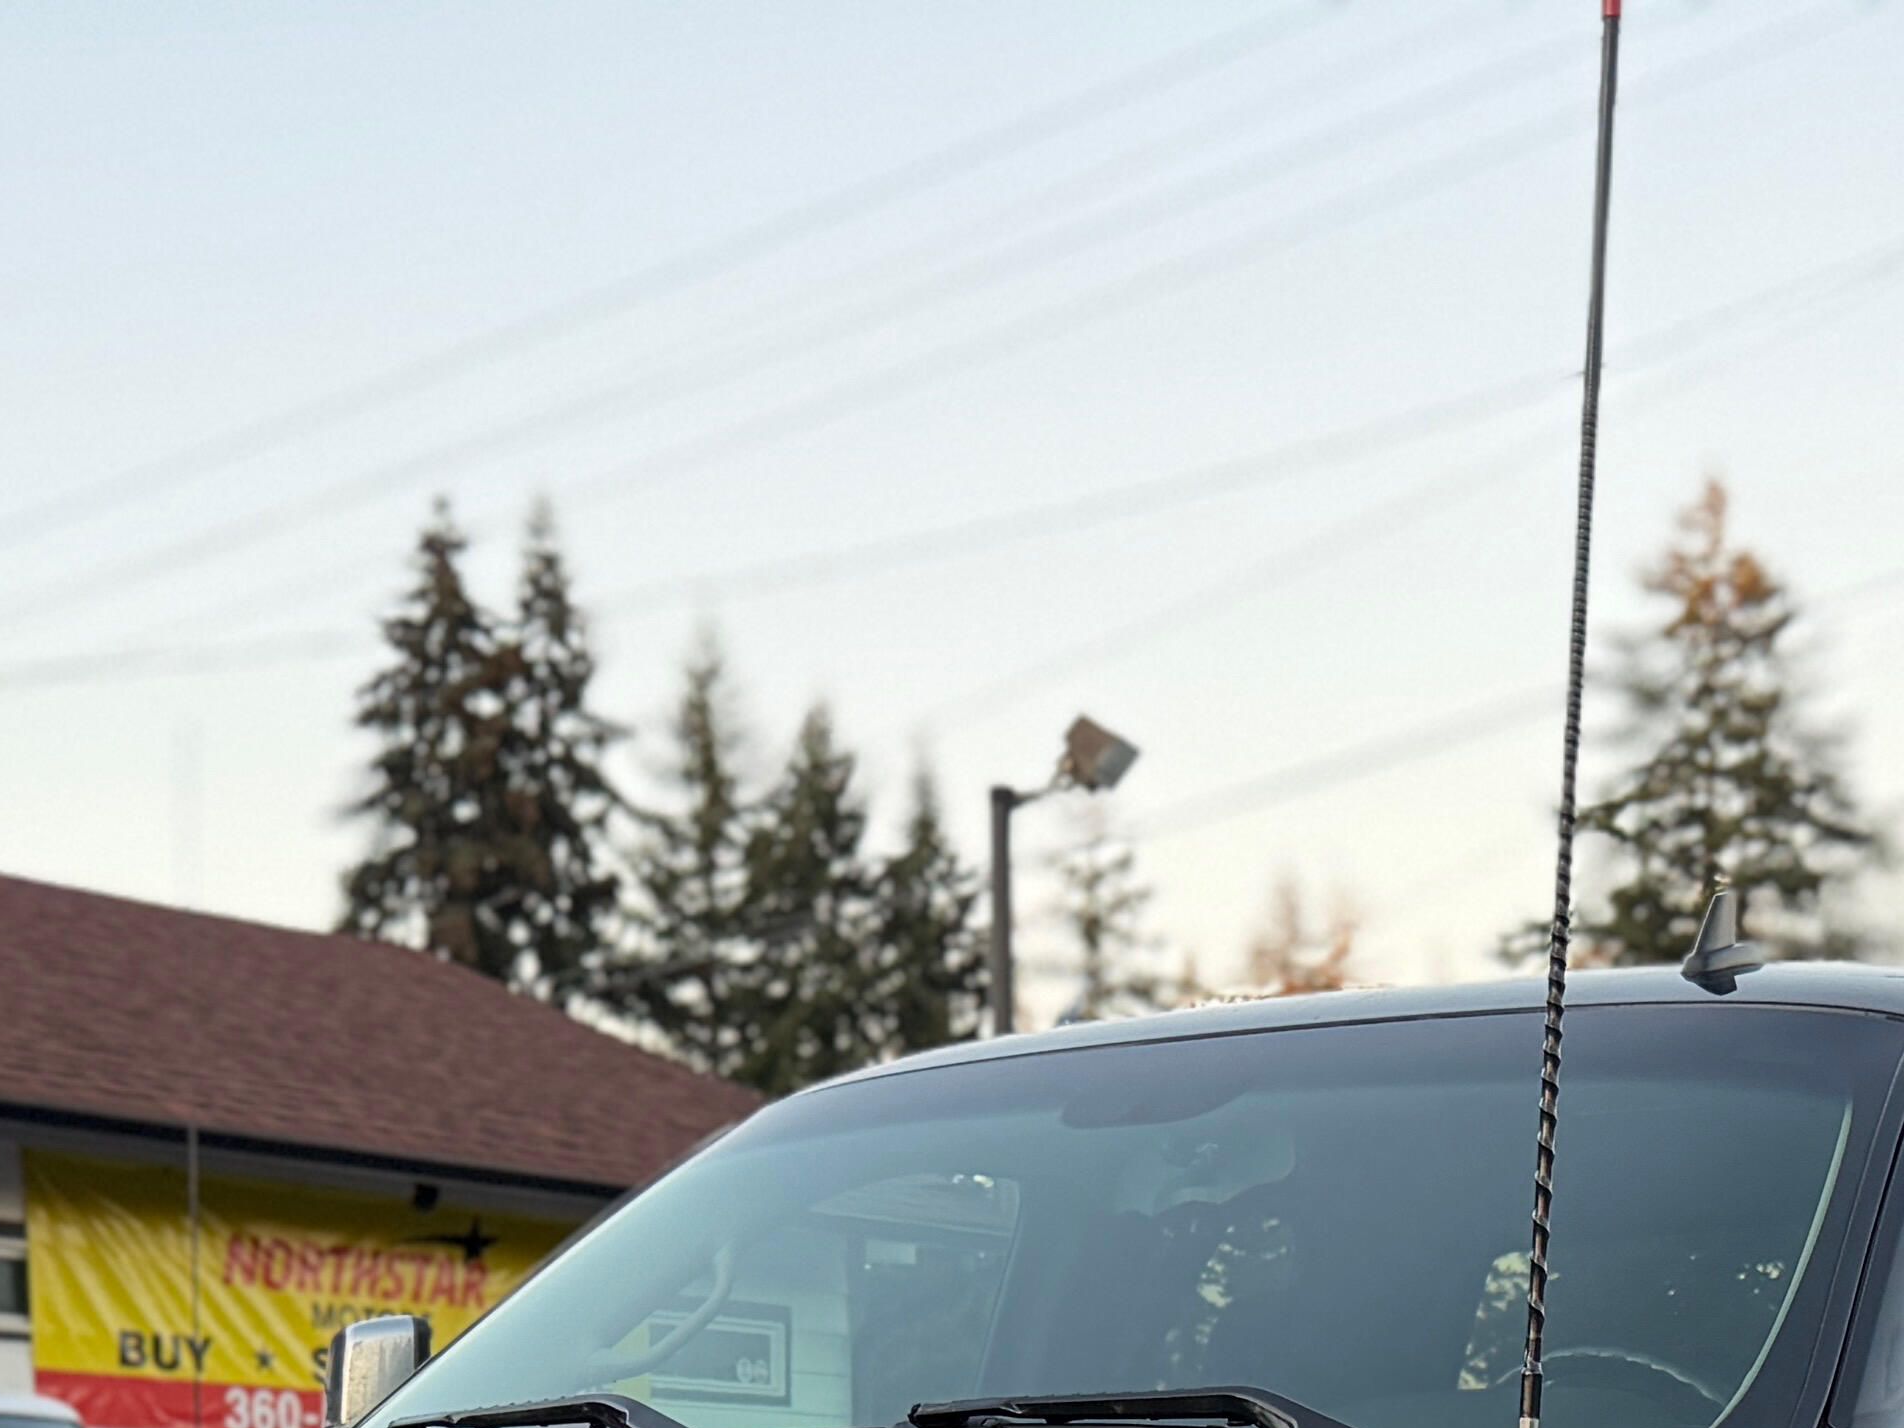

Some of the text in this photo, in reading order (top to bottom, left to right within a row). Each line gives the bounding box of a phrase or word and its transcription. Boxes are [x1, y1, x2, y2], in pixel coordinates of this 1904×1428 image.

[221, 1231, 489, 1309] NORTHSTAR
[311, 1302, 434, 1330] MOT
[118, 1330, 212, 1373] BUY
